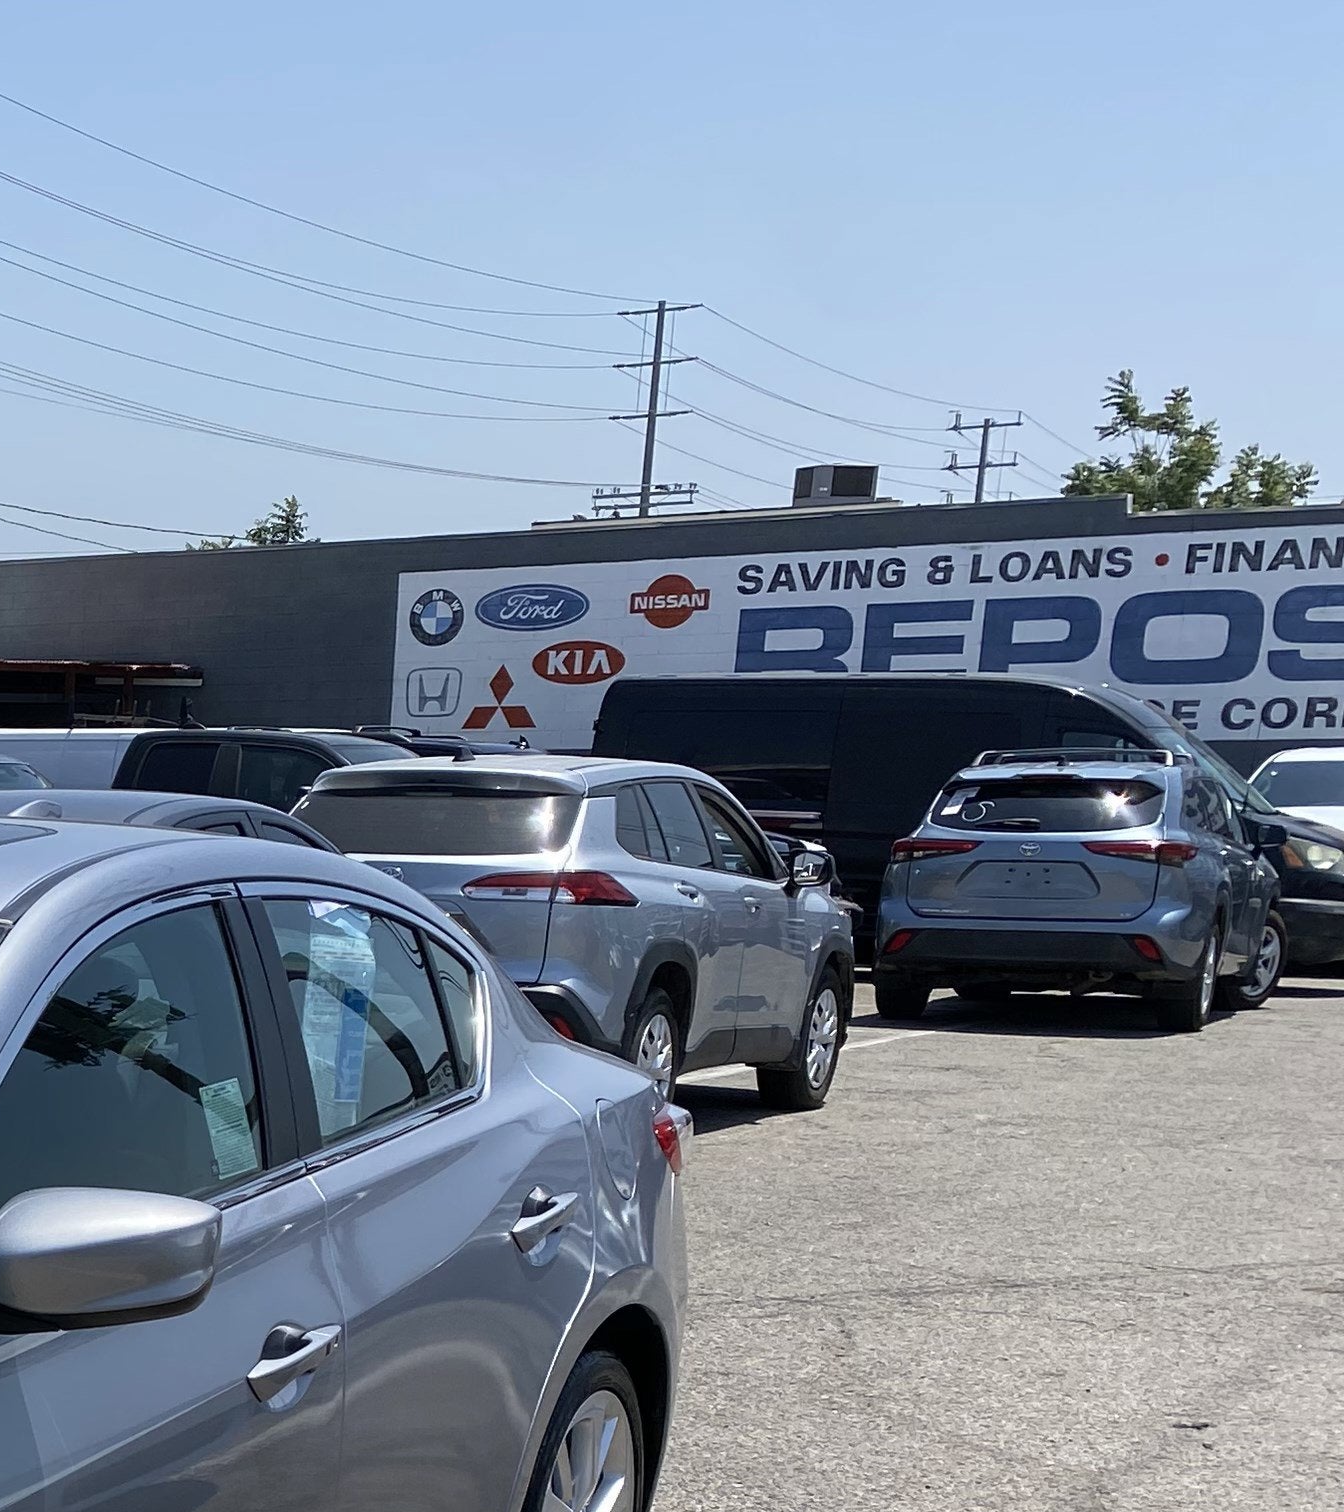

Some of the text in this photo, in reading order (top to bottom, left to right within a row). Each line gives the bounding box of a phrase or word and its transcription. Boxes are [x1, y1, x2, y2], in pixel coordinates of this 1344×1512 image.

[736, 536, 1344, 595] SAVING & LOANS FINAN
[413, 590, 462, 615] BMW
[499, 594, 563, 620] Ford
[634, 592, 706, 610] NISSAN
[546, 649, 612, 676] KIA
[1220, 696, 1344, 730] COR
